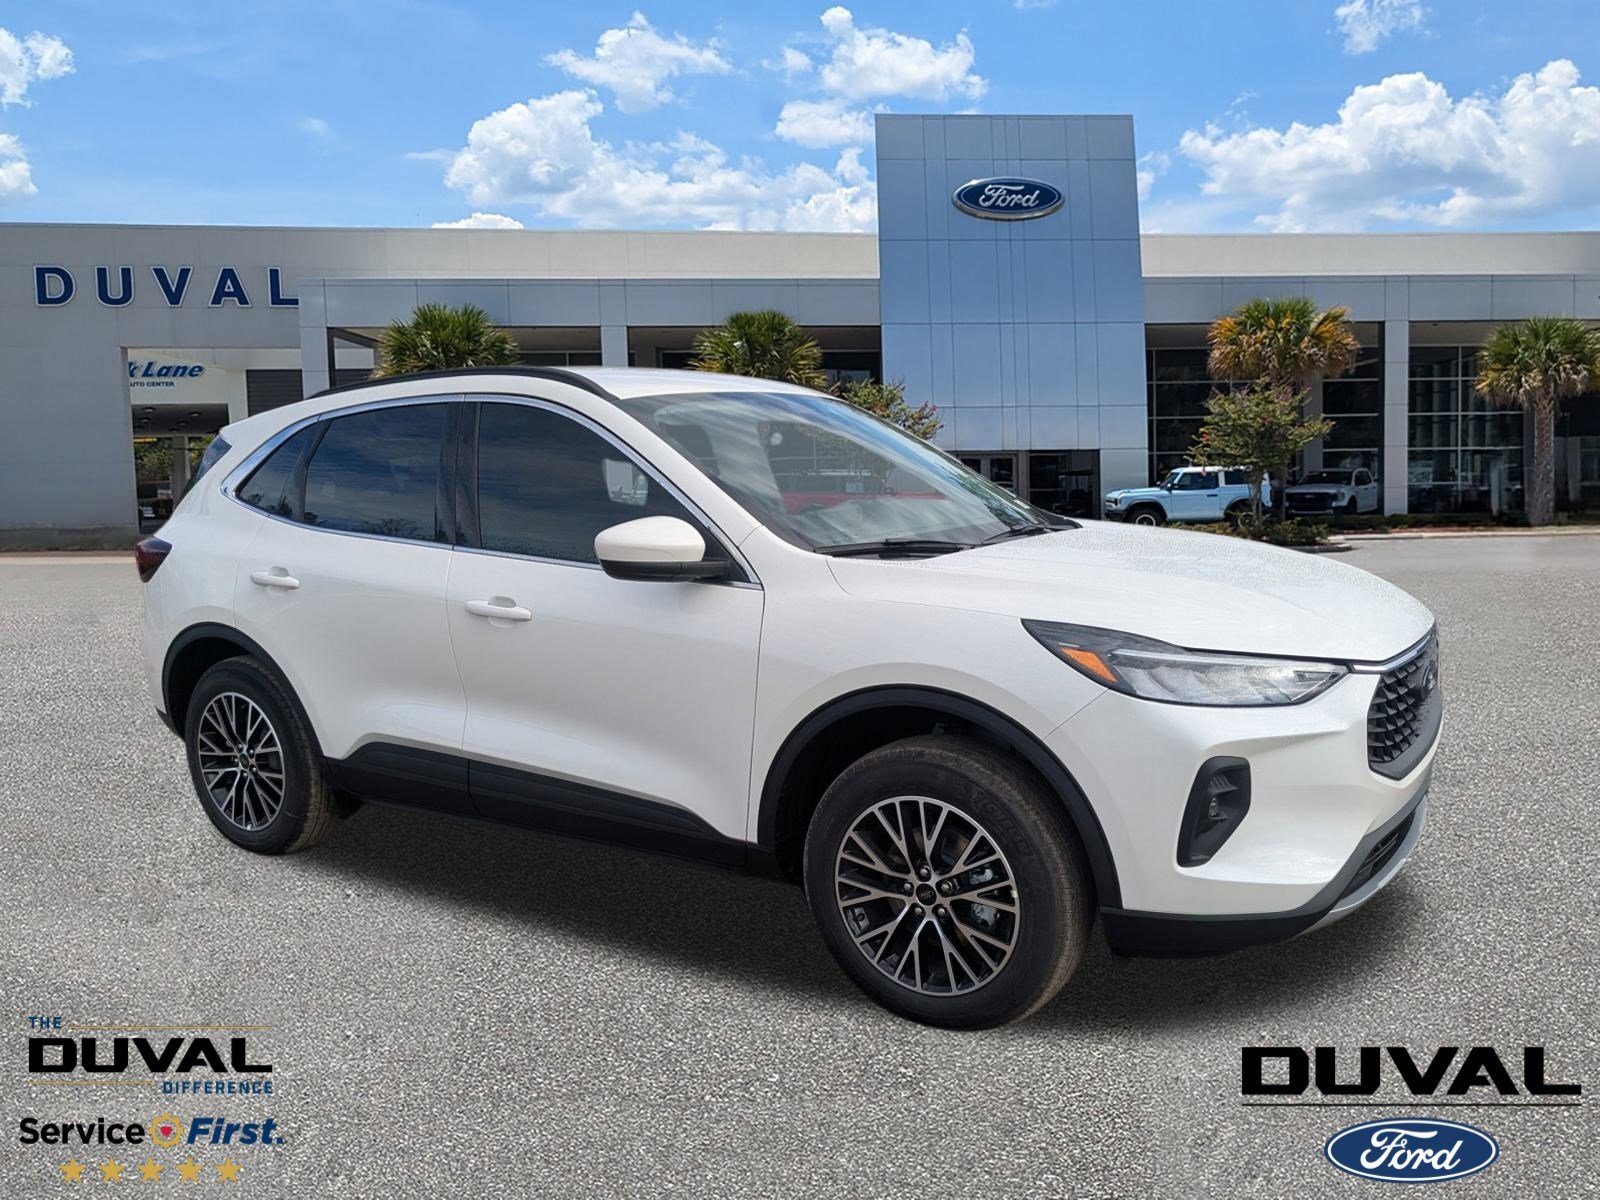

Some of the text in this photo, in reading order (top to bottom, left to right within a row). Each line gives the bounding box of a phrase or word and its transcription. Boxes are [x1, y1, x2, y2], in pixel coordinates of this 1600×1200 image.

[978, 184, 1041, 207] Ford
[33, 265, 299, 308] DUVAL
[141, 361, 205, 378] Lane
